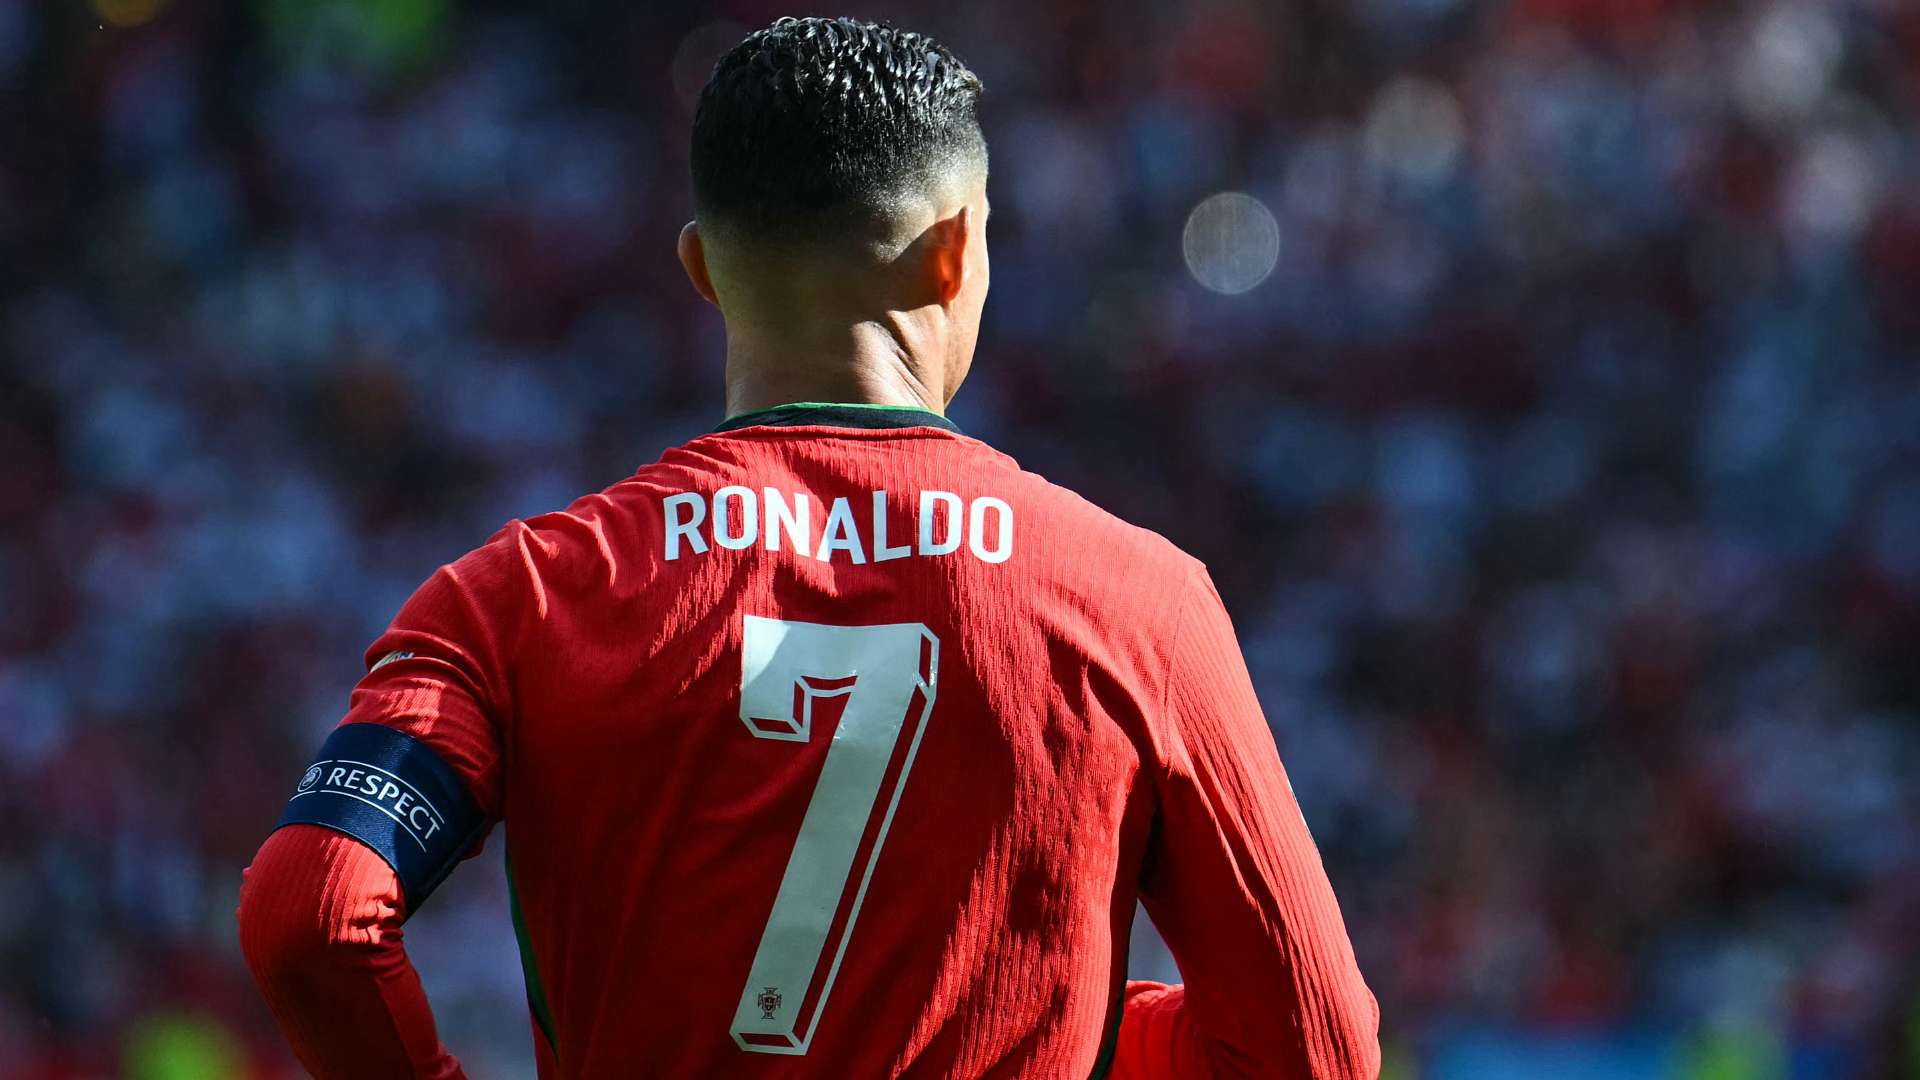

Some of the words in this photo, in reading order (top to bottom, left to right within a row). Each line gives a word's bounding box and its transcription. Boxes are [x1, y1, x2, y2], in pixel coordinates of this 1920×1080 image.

[663, 485, 1014, 564] RONALDO
[326, 767, 440, 840] RESPECT
[729, 614, 940, 1056] 7
